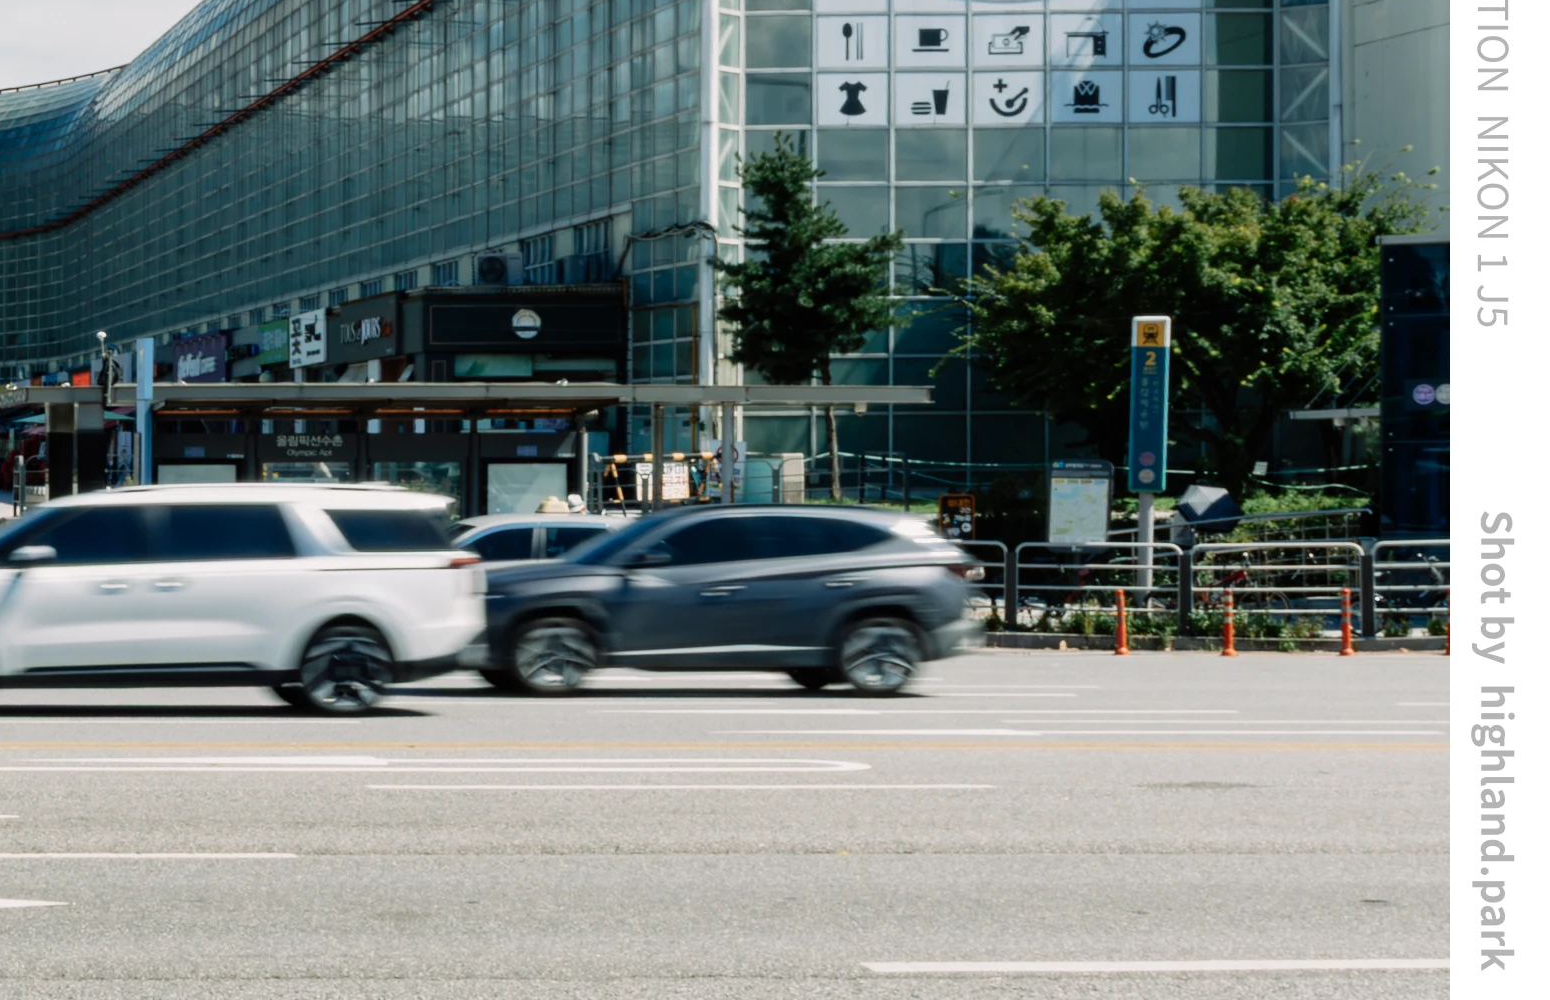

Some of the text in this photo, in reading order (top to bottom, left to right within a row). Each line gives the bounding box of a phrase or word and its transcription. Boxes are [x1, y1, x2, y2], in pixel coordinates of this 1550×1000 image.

[1145, 351, 1157, 366] 2
[276, 435, 343, 447] 올림픽선수촌
[286, 449, 333, 457] Olympic Apt
